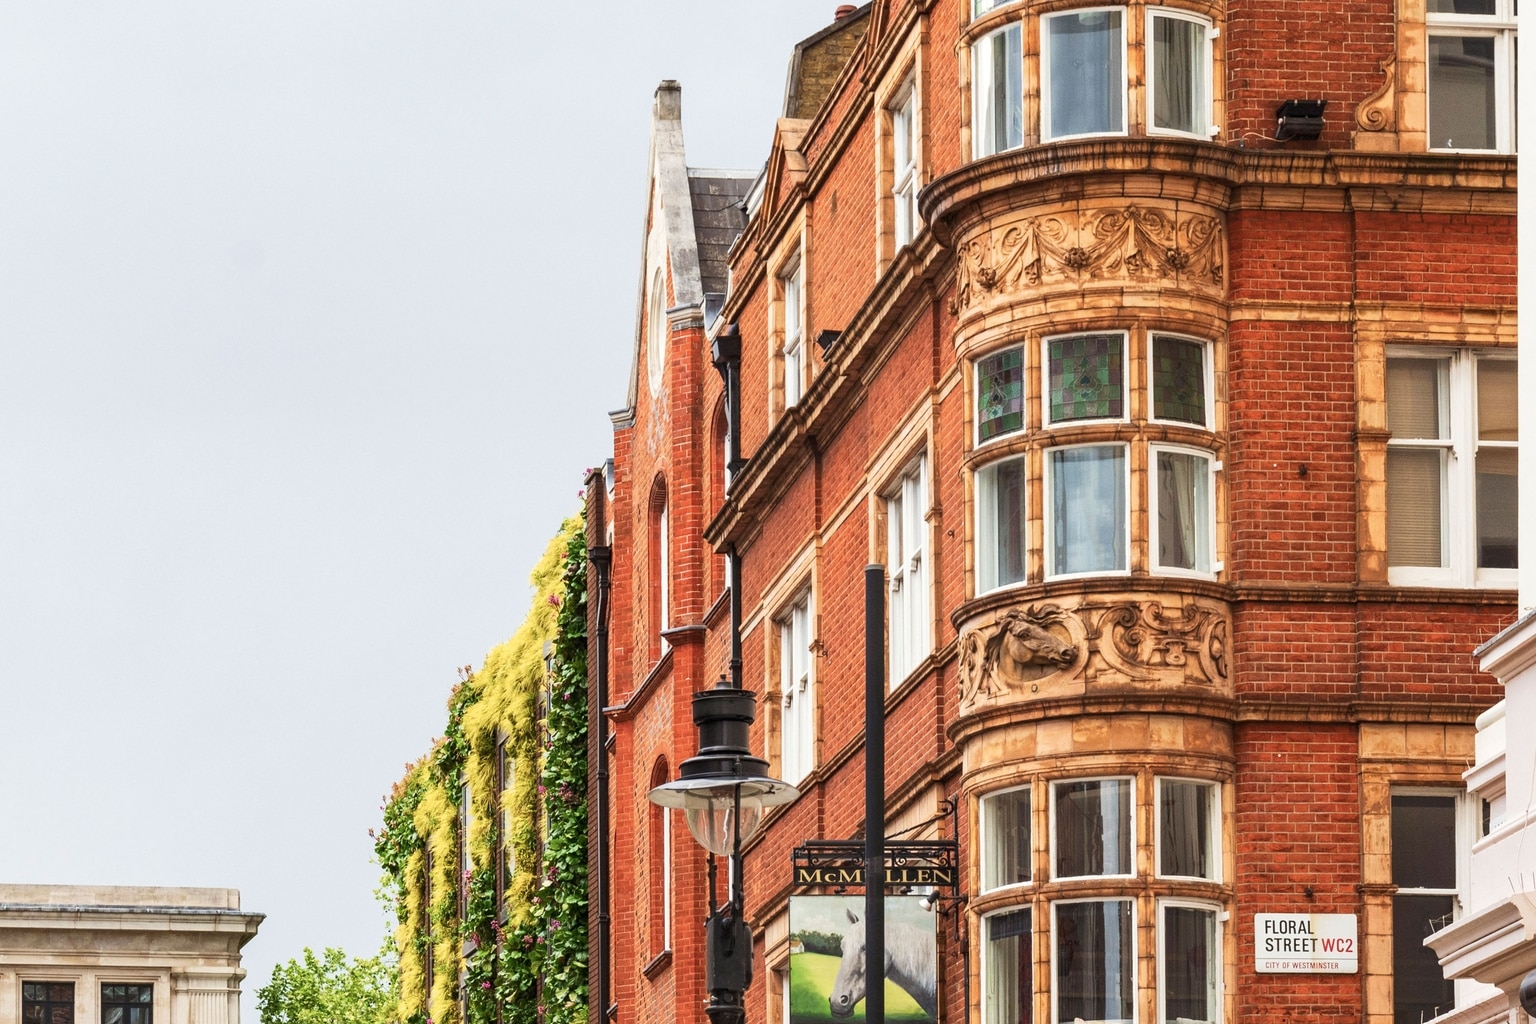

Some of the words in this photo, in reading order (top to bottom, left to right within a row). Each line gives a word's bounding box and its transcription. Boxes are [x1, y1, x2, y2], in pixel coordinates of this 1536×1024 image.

[798, 868, 952, 884] McMLLEN
[1264, 920, 1315, 935] FLORAL
[1265, 937, 1318, 952] STREET
[1321, 938, 1354, 953] WC2
